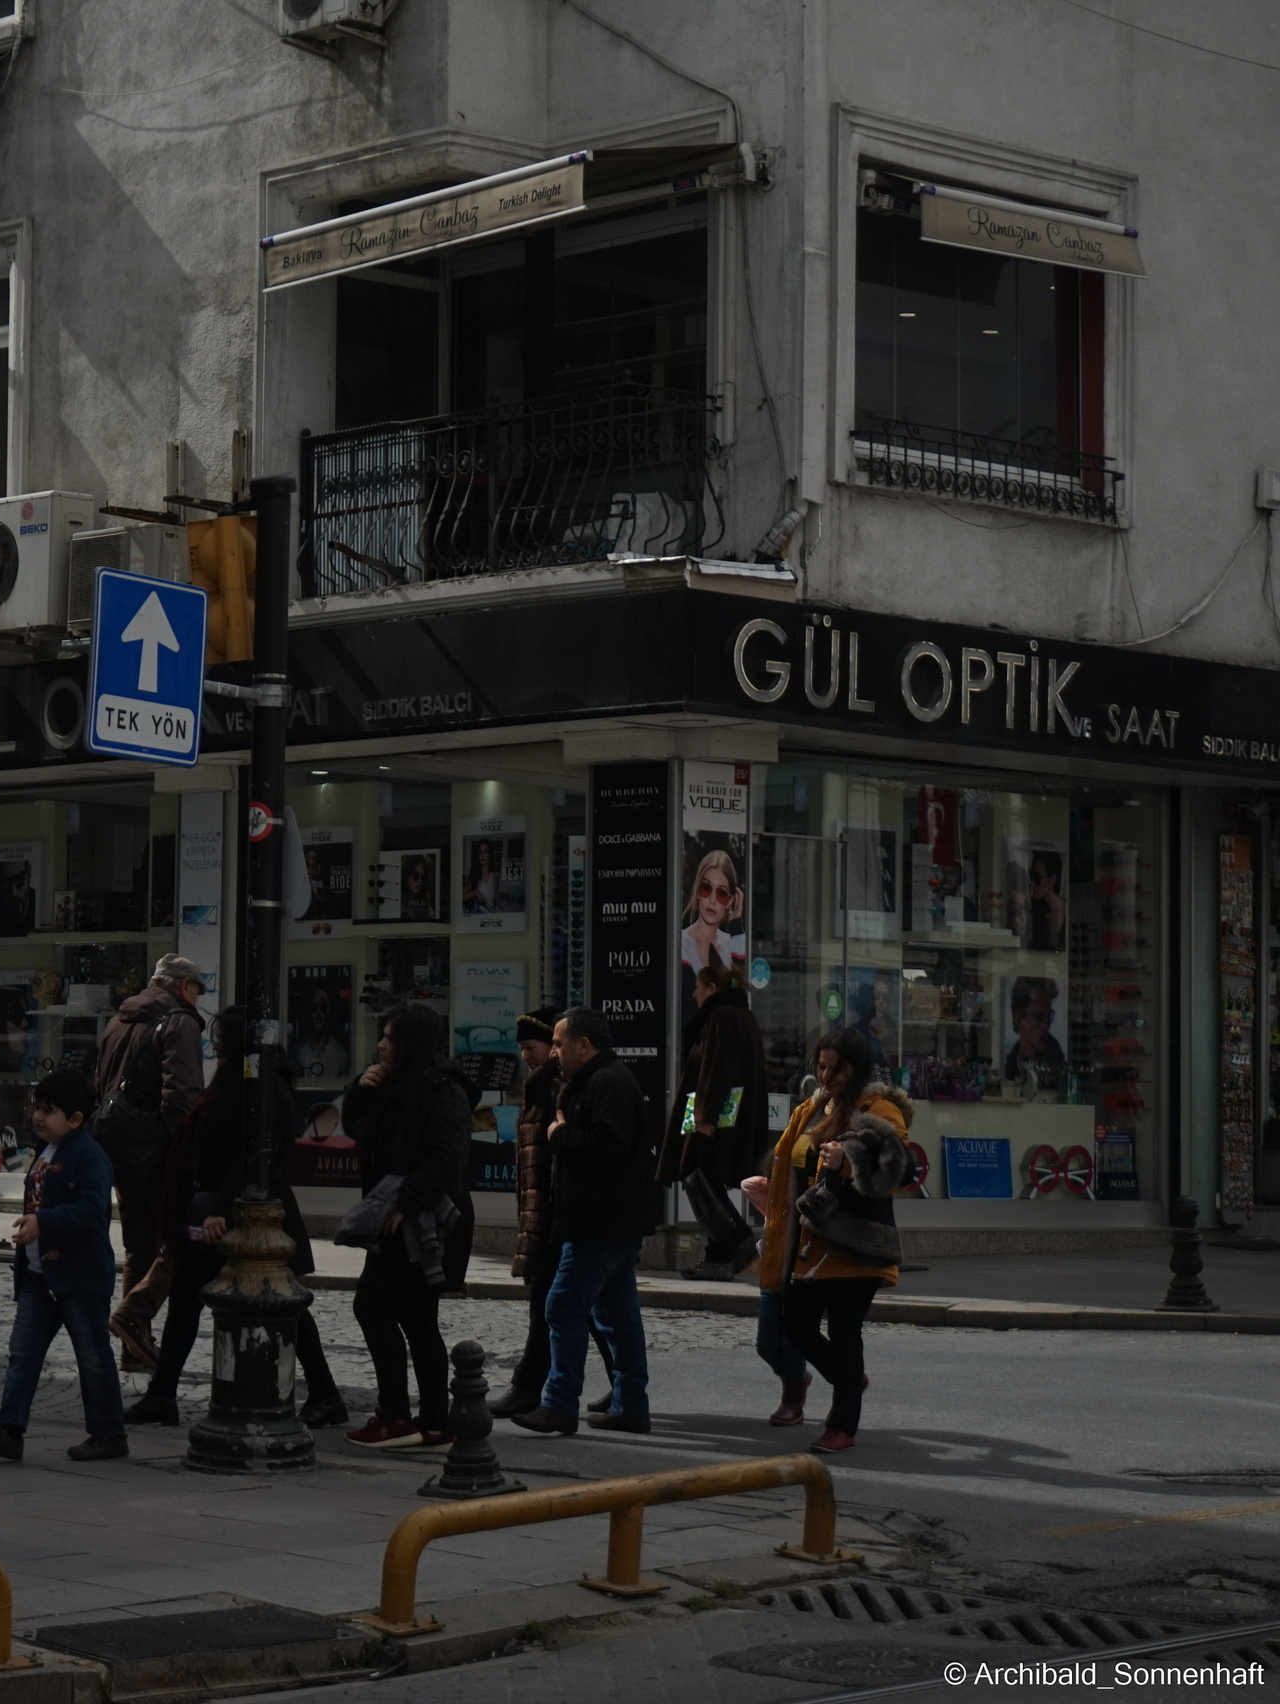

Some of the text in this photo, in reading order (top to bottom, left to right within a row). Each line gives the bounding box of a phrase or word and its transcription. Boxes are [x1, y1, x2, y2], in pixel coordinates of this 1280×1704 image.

[282, 249, 323, 269] Baklava
[339, 225, 412, 260] Ramazan
[419, 199, 479, 235] Canbaz
[498, 191, 529, 211] Turkish
[531, 183, 562, 202] Delight
[967, 207, 1104, 263] Ramazan Canbaz
[20, 523, 48, 535] BEKO
[733, 612, 876, 713] GÜL
[901, 640, 1081, 737] OPTİK
[1106, 704, 1180, 749] SAAT
[1202, 735, 1248, 759] SIDDIK
[1250, 741, 1280, 762] BAL
[225, 711, 244, 731] VE
[362, 697, 416, 721] SIDDIK
[419, 692, 472, 717] BALCI
[105, 707, 187, 739] TEK YÖN
[600, 787, 659, 797] BURBERRY
[502, 867, 524, 881] BEST
[330, 875, 351, 890] RIDE
[608, 951, 650, 967] POLO
[471, 994, 508, 1004] Progressive
[602, 999, 656, 1013] PRADA
[957, 1140, 999, 1154] ACUVUE
[316, 1156, 359, 1171] AVIATO
[484, 1163, 517, 1179] BLAZ
